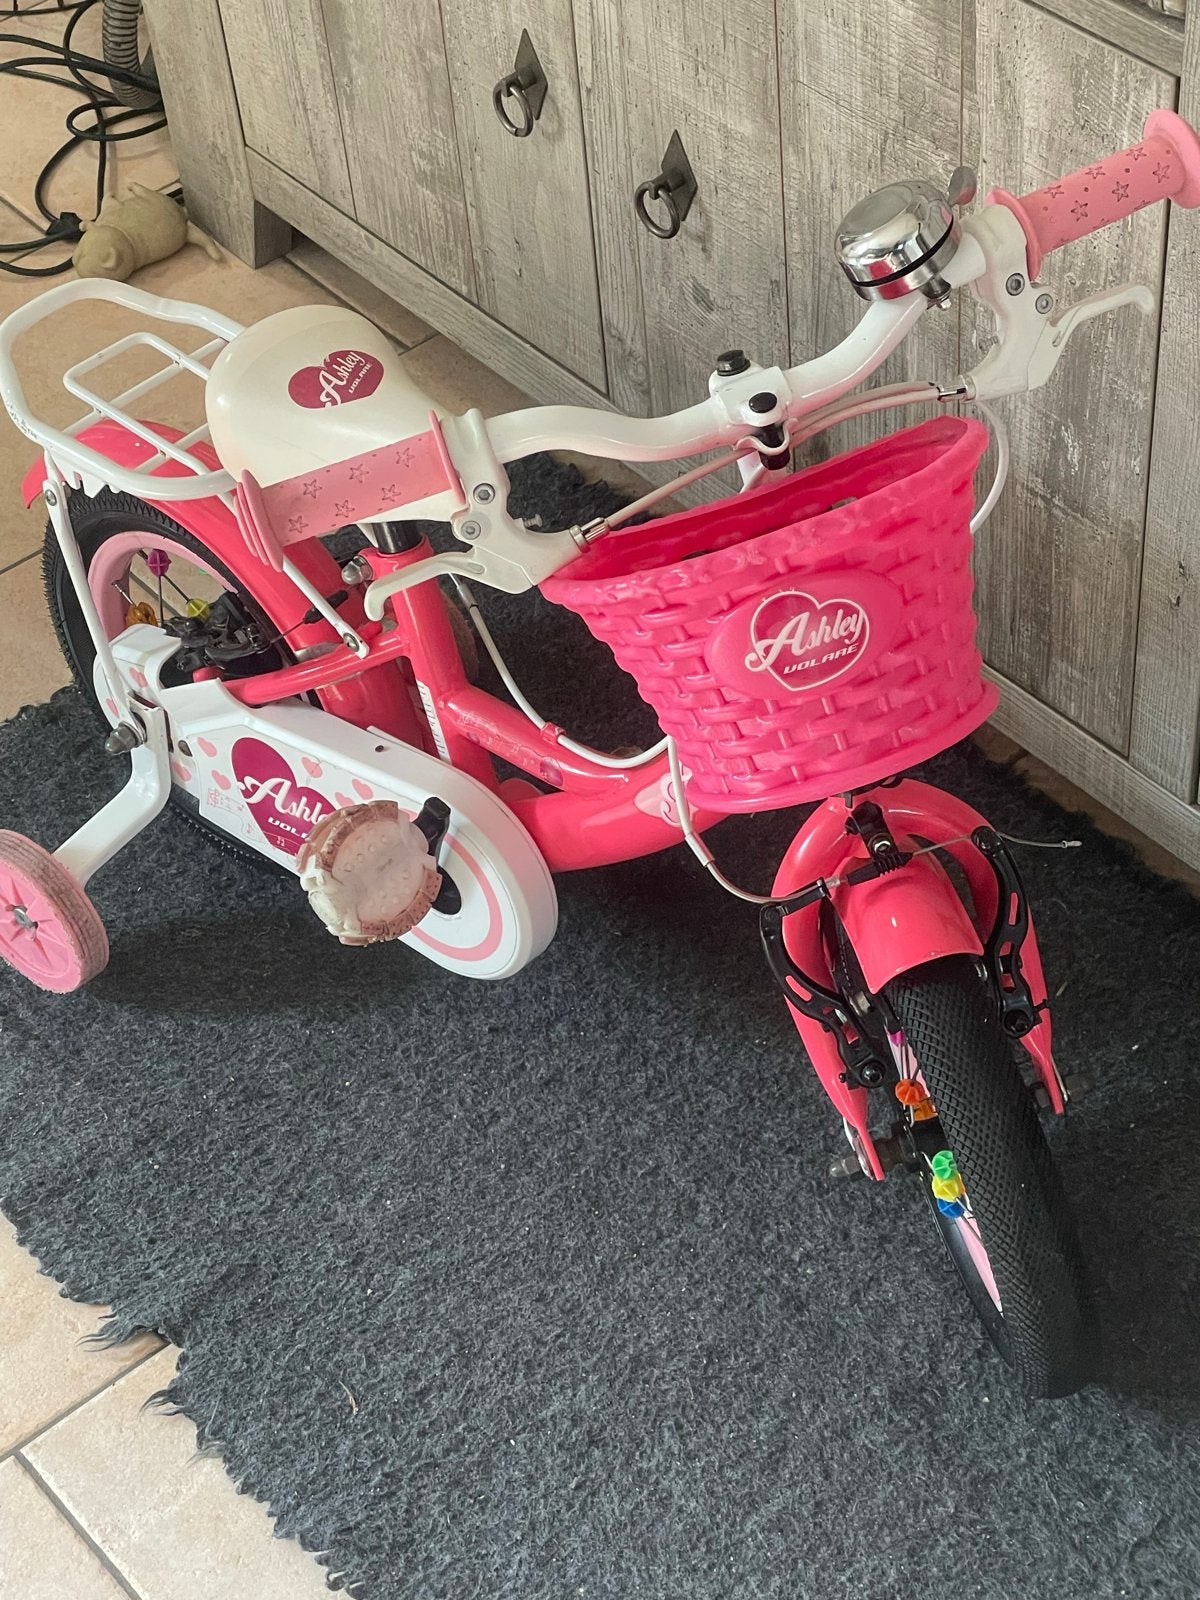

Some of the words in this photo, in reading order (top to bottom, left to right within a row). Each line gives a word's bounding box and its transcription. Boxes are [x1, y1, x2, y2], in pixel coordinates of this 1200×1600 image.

[319, 351, 366, 406] Ashley
[744, 608, 866, 672] Ashley
[783, 642, 859, 675] VOLARE
